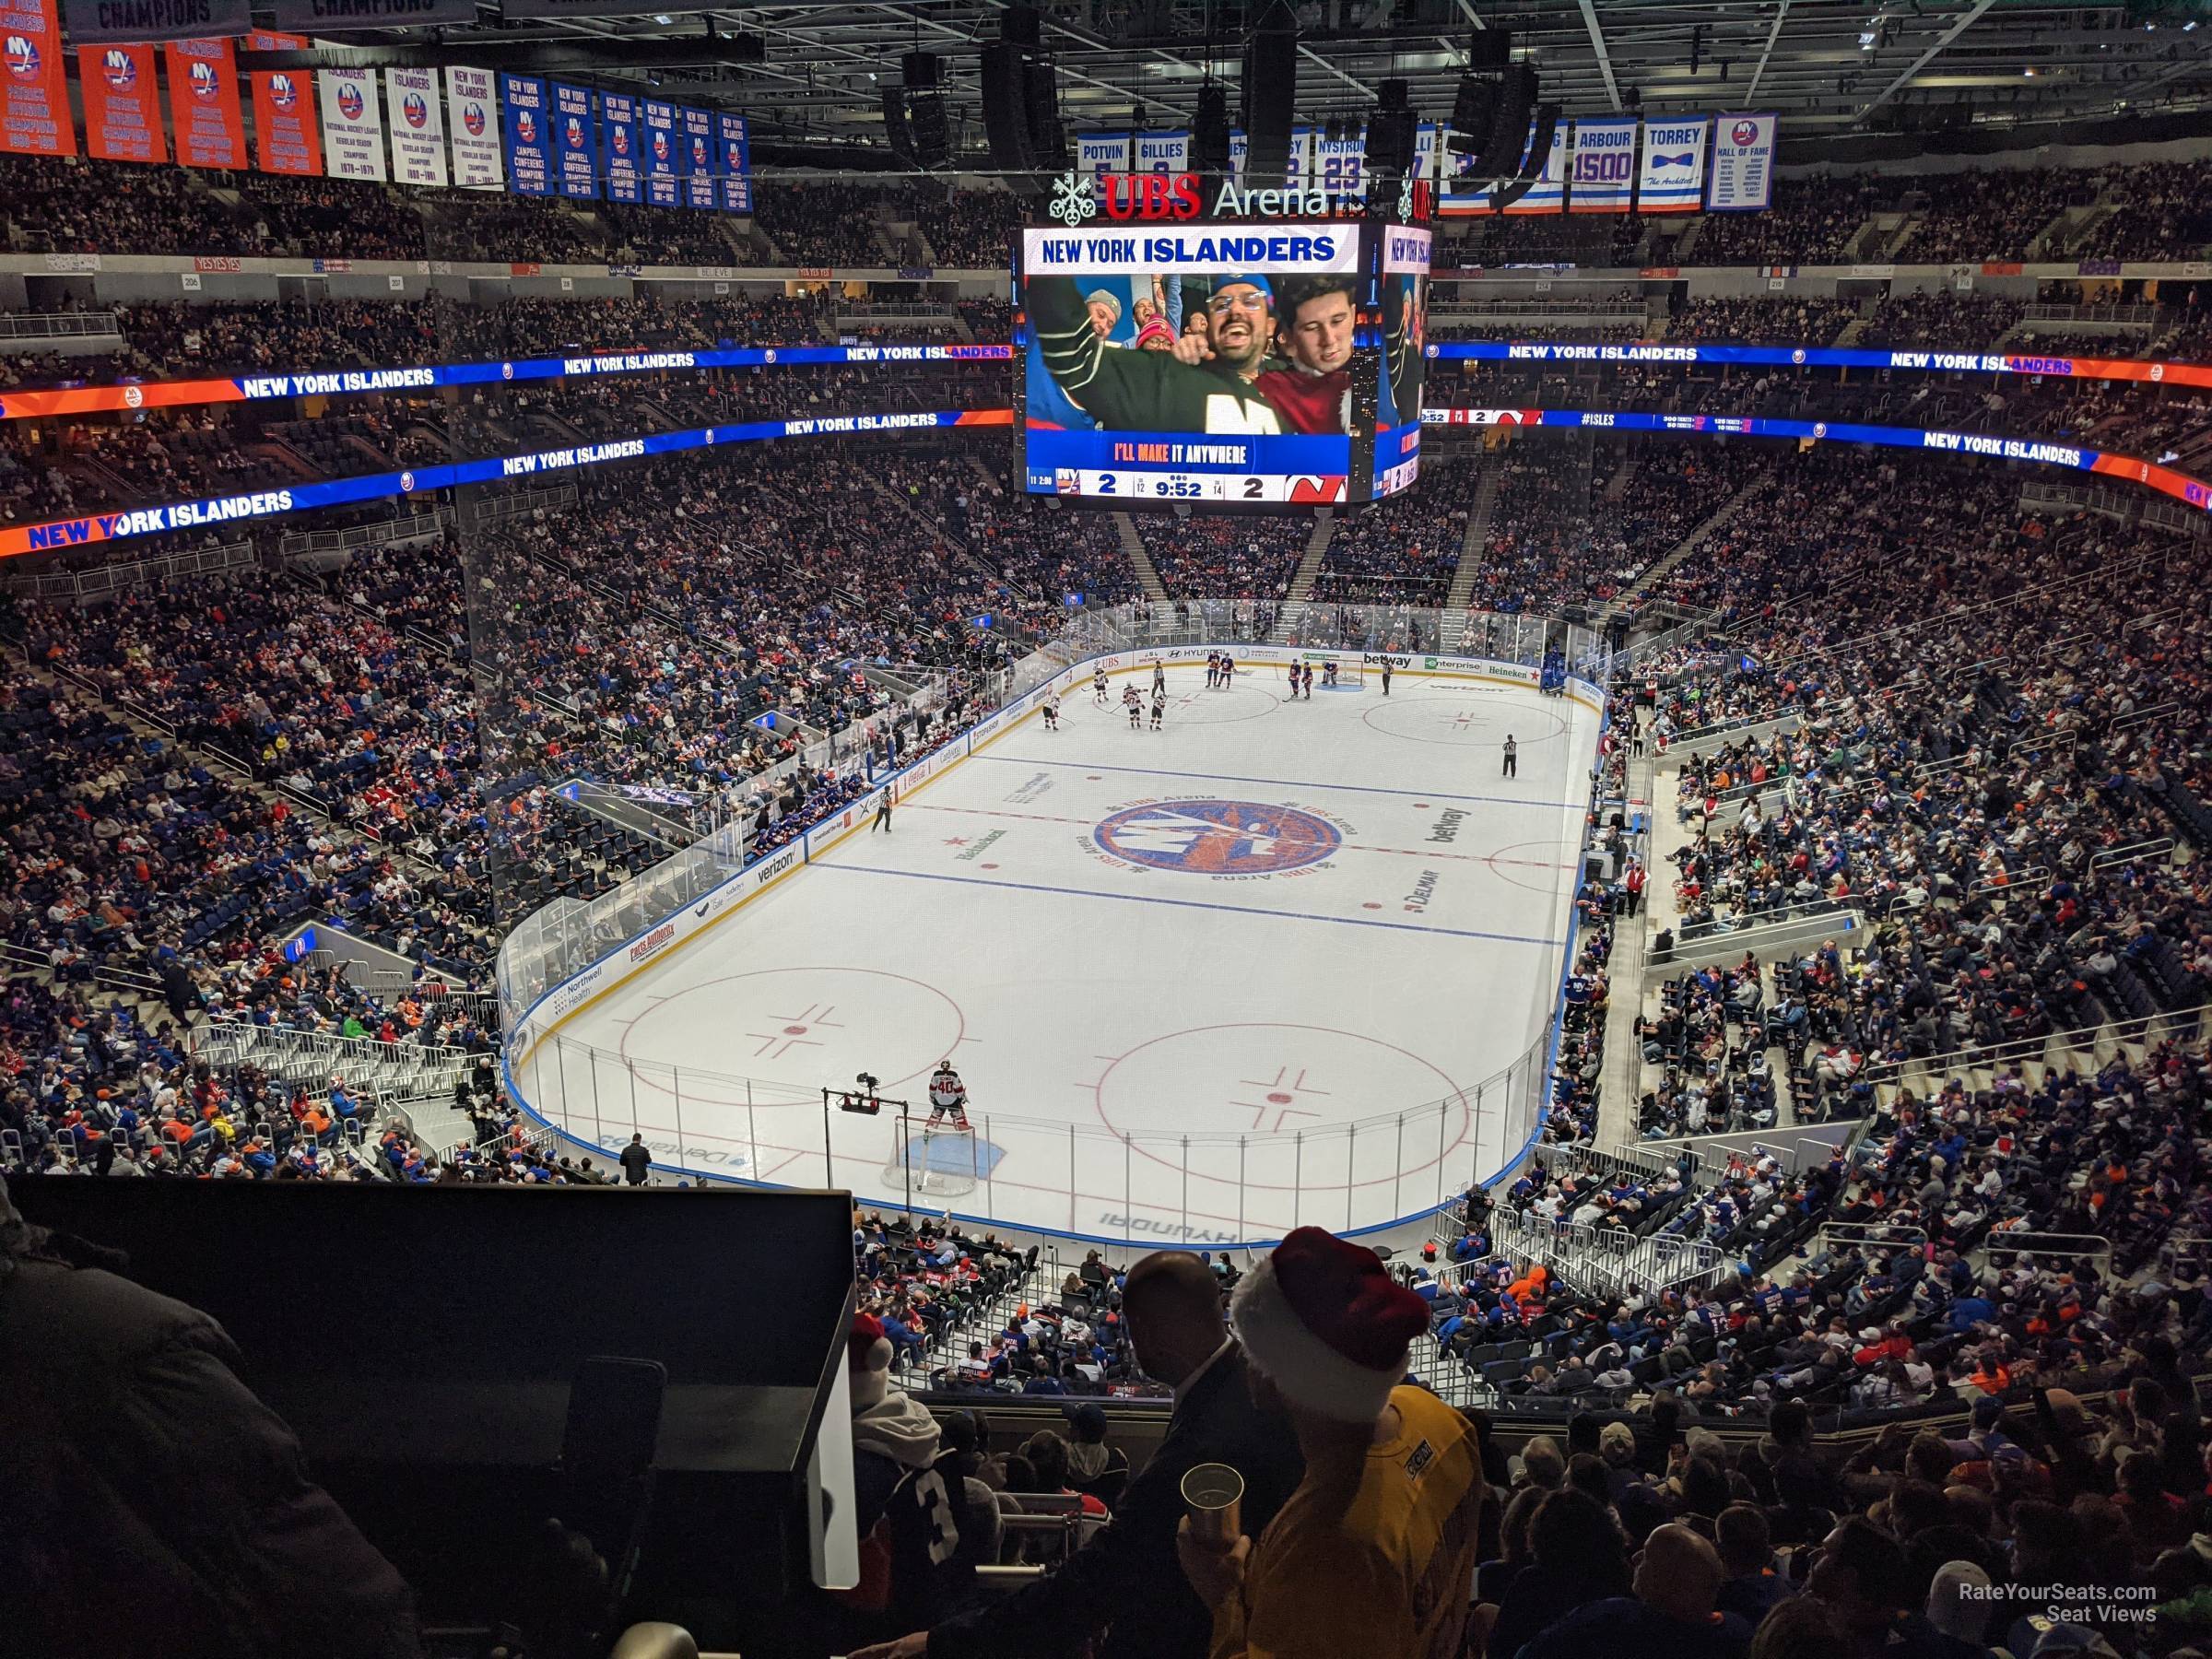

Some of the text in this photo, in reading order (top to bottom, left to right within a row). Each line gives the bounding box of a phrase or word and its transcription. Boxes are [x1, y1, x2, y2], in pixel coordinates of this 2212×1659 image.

[99, 1, 211, 29] CHAMPIONS
[394, 73, 429, 90] ISLANDERS
[454, 70, 487, 86] NEW YORK
[456, 85, 488, 100] ISLANDERS
[509, 79, 538, 94] NEW YORK
[510, 93, 539, 108] ISLANDERS
[559, 88, 585, 102] NEW YORK
[559, 101, 587, 115] ISLANDERS
[606, 97, 630, 111] NEW YORK
[606, 109, 631, 123] ISLANDERS
[1580, 132, 1630, 147] ARBOUR
[1651, 128, 1700, 145] TORREY
[344, 151, 368, 159] CHAMPIONS
[1084, 145, 1123, 159] POTVIN
[1141, 143, 1182, 158] GILLIES
[1718, 147, 1769, 157] HALL OF FAME
[514, 157, 545, 169] CONFERENCE
[1573, 152, 1632, 181] 1500
[516, 169, 545, 181] CHAMPIONS
[1324, 158, 1360, 190] 23
[1101, 173, 1328, 219] UBS Arena
[1042, 236, 1335, 264] NEW YORK ISLANDERS
[1392, 238, 1405, 262] NEW
[1406, 239, 1417, 263] YORK
[199, 257, 241, 271] YES YES YES
[847, 347, 1009, 360] NEW YORK ISLANDERS
[1509, 346, 1697, 360] NEW YORK ISLANDERS
[564, 352, 695, 375] NEW YORK ISLANDERS
[1890, 352, 2072, 375] NEW YORK ISLANDERS
[244, 368, 434, 399] NEW YORK ISLANDERS
[1476, 412, 1486, 421] 2
[1582, 414, 1614, 426] #ISLES
[785, 414, 937, 435] NEW YORK ISLANDERS
[1114, 442, 1246, 464] I'LL MAKE IT ANYWHERE
[1924, 432, 2080, 466] NEW YORK ISLANDERS
[502, 440, 644, 476] NEW YORK ISLANDERS
[1099, 474, 1116, 493] 2
[1136, 483, 1145, 492] 12
[1395, 472, 1401, 488] 2
[1156, 481, 1201, 496] 9:52
[1213, 486, 1221, 495] 14
[1244, 478, 1263, 498] 2
[2185, 482, 2202, 502] NEW
[29, 490, 292, 550] NEW YORK ISLANDERS
[1102, 657, 1119, 668] UBS
[1364, 653, 1411, 668] betway
[1427, 658, 1480, 671] enterprise
[1488, 665, 1527, 678] Heineken
[1430, 684, 1506, 692] verizon
[1124, 797, 1158, 807] UBS
[1303, 806, 1333, 818] UBS
[1425, 807, 1472, 842] betway
[759, 851, 793, 883] verizon
[629, 940, 646, 959] Parts
[647, 924, 675, 947] Authority
[568, 966, 602, 994] Northwell
[569, 987, 591, 1007] Health
[938, 1081, 953, 1093] 40
[1100, 1213, 1236, 1242] HYUNDAI
